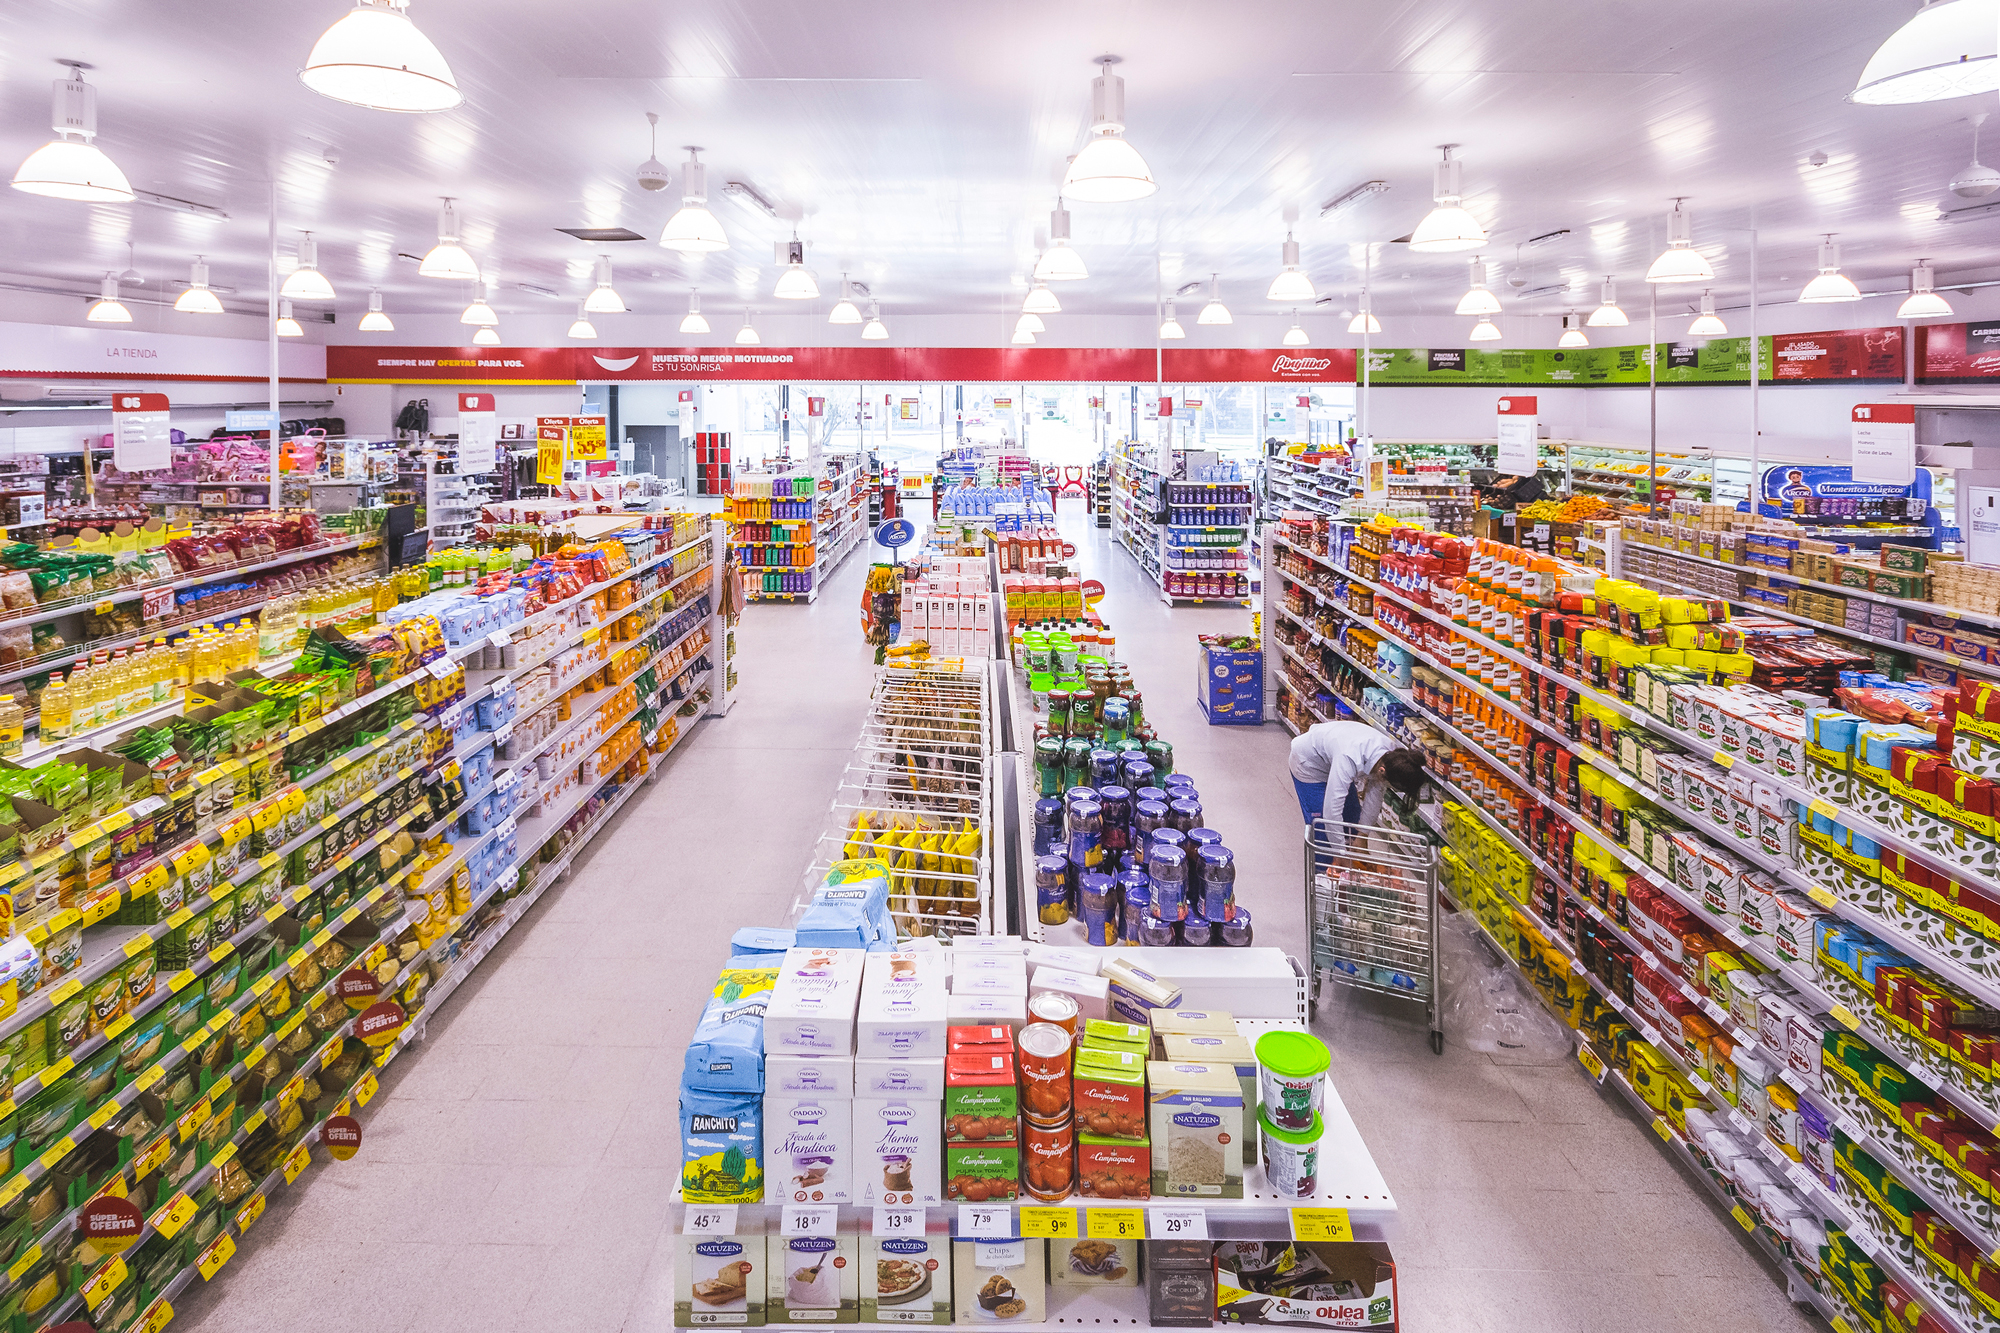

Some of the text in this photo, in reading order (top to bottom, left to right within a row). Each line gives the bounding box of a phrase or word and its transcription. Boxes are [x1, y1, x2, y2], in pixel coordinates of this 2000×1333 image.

[107, 348, 157, 358] LA TIENDA
[122, 397, 140, 408] 06
[1855, 408, 1871, 418] 11
[544, 430, 558, 438] Oferta
[1821, 485, 1904, 495] Momentos Mágicos
[1075, 704, 1088, 712] BC
[1892, 784, 1931, 806] AGUANTADORA
[263, 814, 268, 822] 5
[1940, 804, 1986, 828] AGUANTADORA
[234, 829, 240, 837] 5
[187, 856, 194, 865] 5
[219, 857, 236, 872] Quick
[145, 878, 152, 888] 5
[193, 872, 211, 888] Quick
[1884, 873, 1923, 899] AGUANTADORA
[163, 888, 183, 905] Quick
[97, 906, 104, 917] 5
[1930, 897, 1980, 926] AGUANTADORA
[192, 936, 208, 952] Quick
[52, 944, 78, 964] Quick
[132, 977, 154, 994] Quick
[344, 983, 373, 992] OFERTA
[362, 1014, 385, 1024] SÚPER
[364, 1016, 398, 1032] OFERTA
[64, 1024, 85, 1042] Quick
[1024, 1064, 1066, 1082] Campagnola
[1918, 1070, 1927, 1078] 13
[1786, 1076, 1795, 1084] 22
[961, 1095, 1000, 1106] Campagnola
[1089, 1089, 1129, 1102] Campagnola
[191, 1118, 197, 1128] 6
[693, 1117, 736, 1131] RANCHITO
[329, 1132, 357, 1141] OFERTA
[787, 1131, 827, 1142] Fécula de
[874, 1126, 919, 1144] Harina
[774, 1142, 838, 1154] Mandioca
[876, 1144, 918, 1154] de arroz
[962, 1156, 1002, 1168] Campagnola
[1095, 1152, 1135, 1164] Campagnola
[171, 1214, 180, 1223] 6
[694, 1215, 709, 1228] 45
[795, 1217, 809, 1228] 18
[887, 1215, 901, 1227] 13
[972, 1214, 980, 1227] 7
[90, 1219, 136, 1230] OFERTA
[1051, 1220, 1059, 1232] 9
[1118, 1222, 1126, 1234] 8
[1167, 1219, 1192, 1232] 29 97
[1325, 1225, 1336, 1235] 10
[988, 1247, 1010, 1256] Chips
[212, 1254, 219, 1264] 6
[101, 1280, 109, 1291] 6
[1219, 1289, 1238, 1302] ¡NUEVA!
[1276, 1304, 1310, 1315] Gallo
[1373, 1302, 1386, 1311] 99
[1316, 1305, 1364, 1320] oblea
